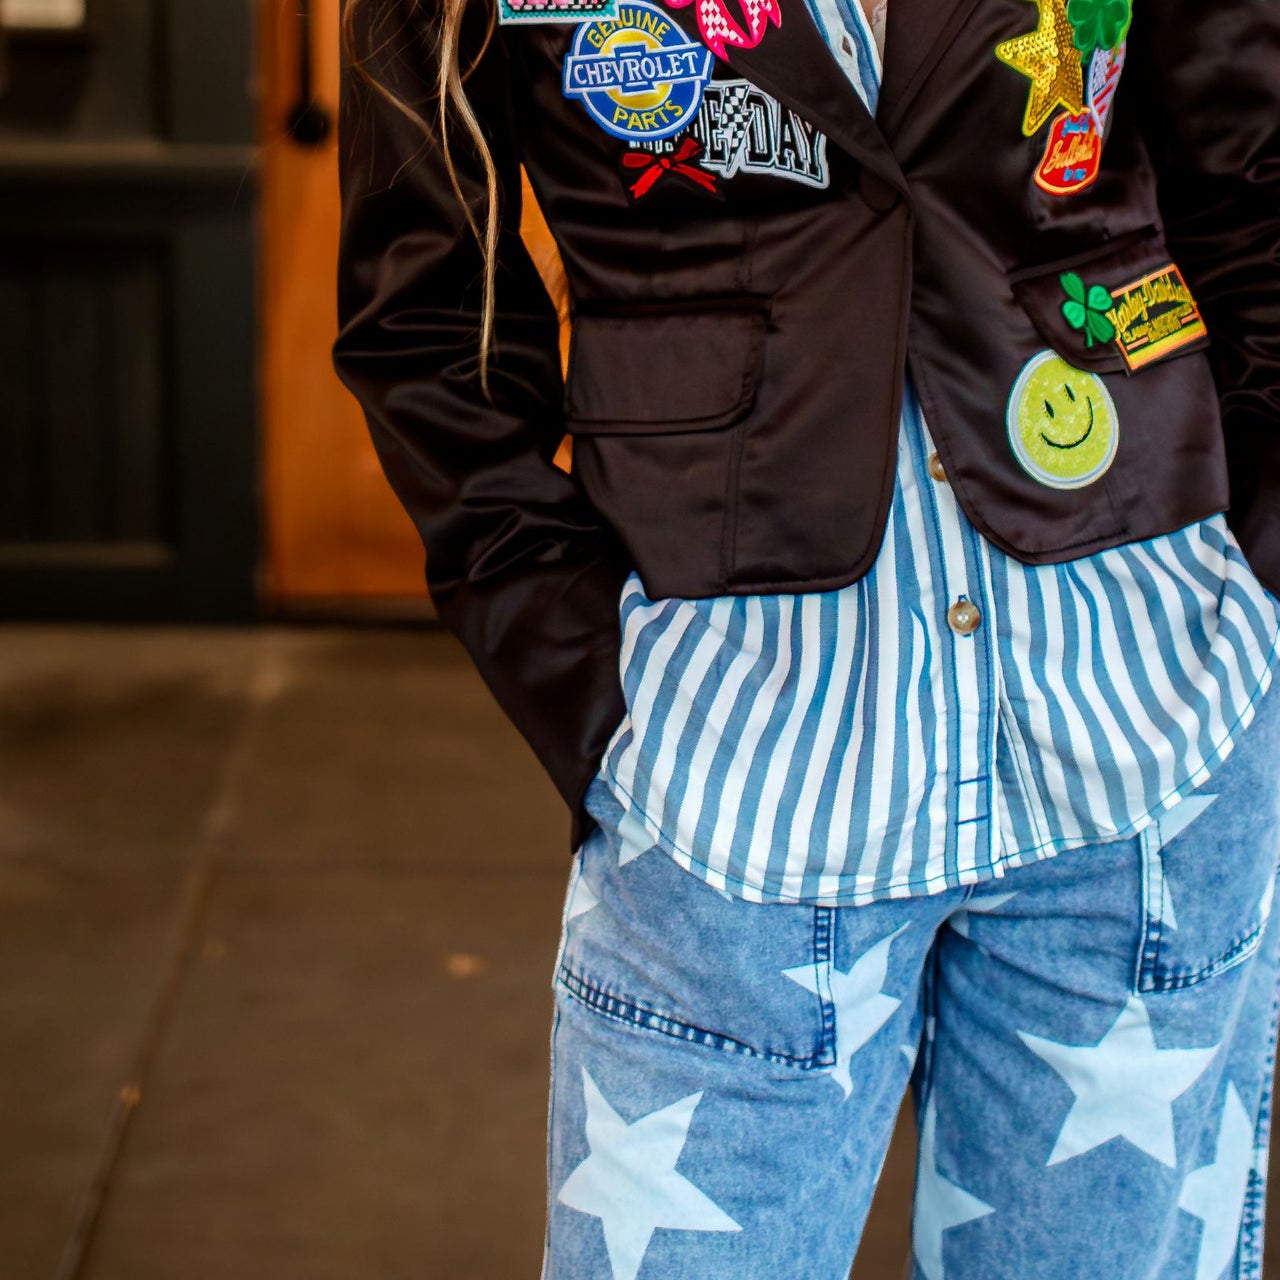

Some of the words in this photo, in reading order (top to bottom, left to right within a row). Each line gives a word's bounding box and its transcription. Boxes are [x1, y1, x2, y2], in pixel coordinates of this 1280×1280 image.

[587, 9, 671, 49] GENUINE
[574, 51, 699, 85] CHEVROLET
[613, 100, 684, 130] PARTS
[742, 91, 827, 183] DAY
